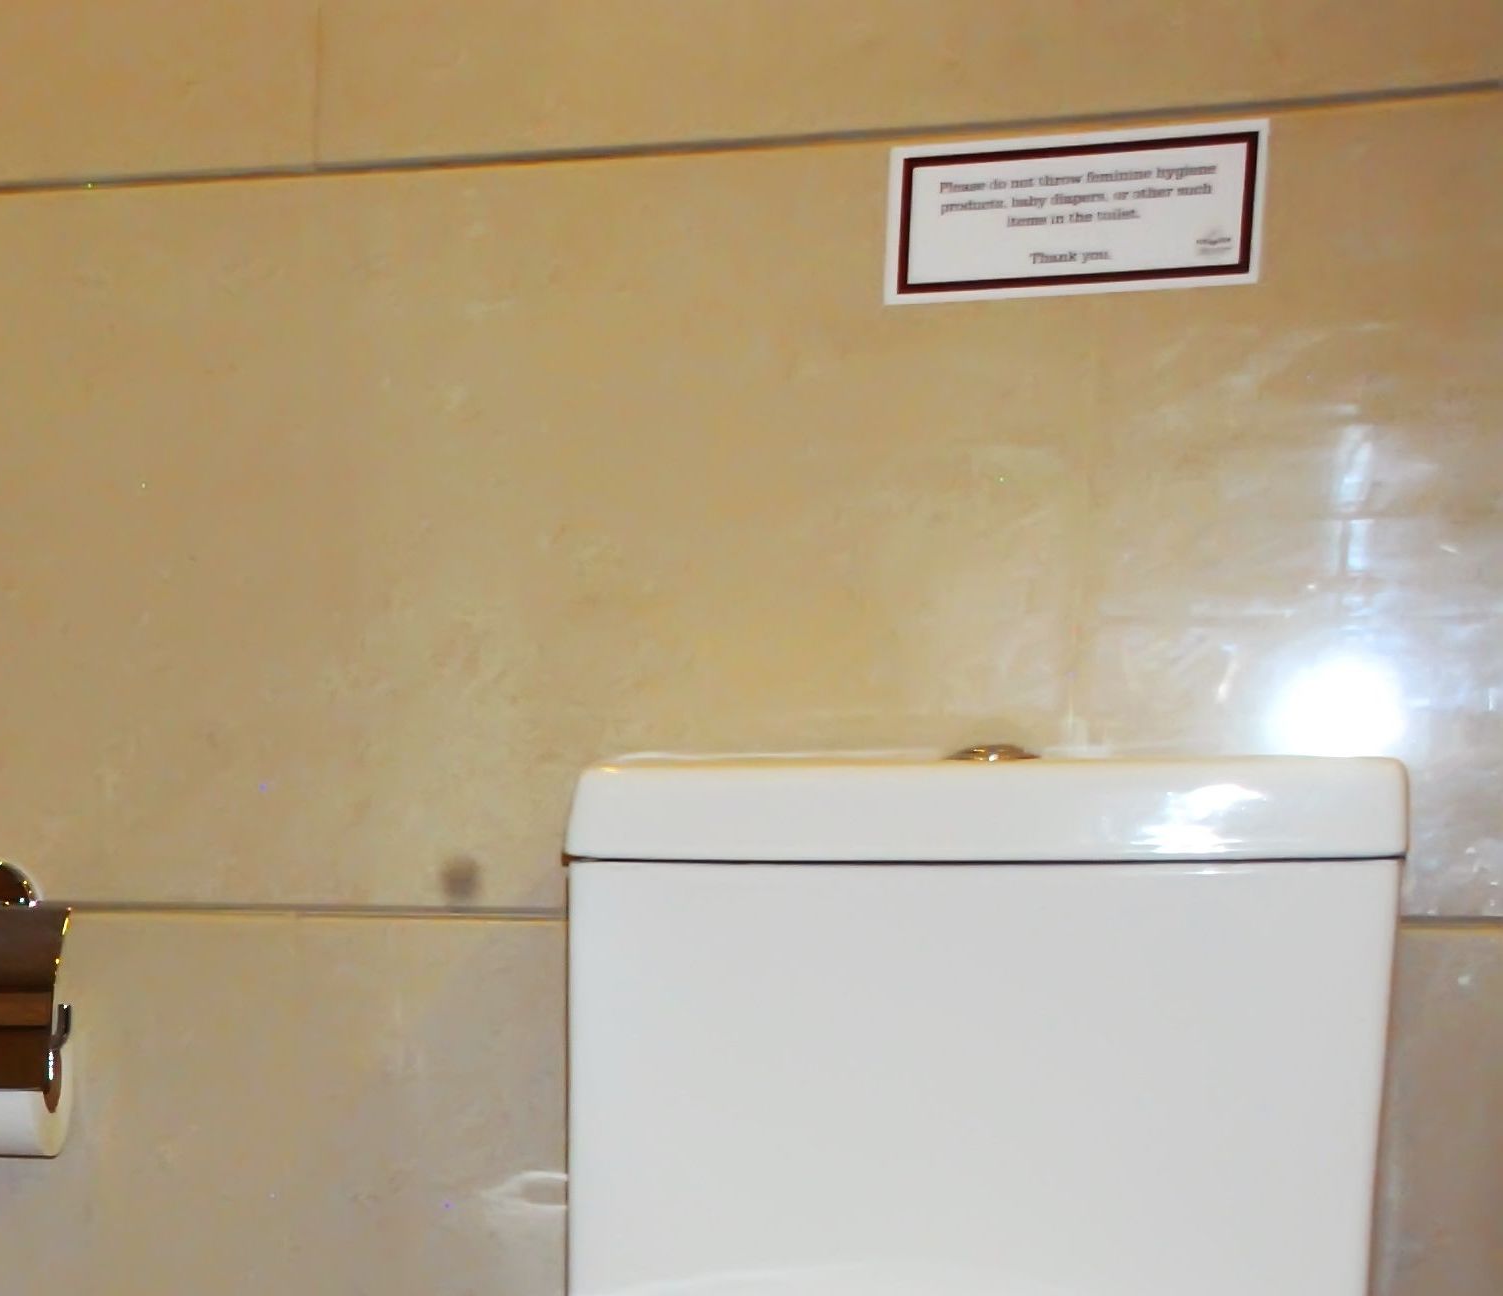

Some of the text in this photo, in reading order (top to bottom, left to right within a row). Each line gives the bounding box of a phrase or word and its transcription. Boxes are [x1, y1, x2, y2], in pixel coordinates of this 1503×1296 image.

[940, 164, 1217, 193] Please do not throw feminine hygiene
[1012, 196, 1047, 208] baby
[1113, 191, 1129, 200] or
[1133, 187, 1173, 199] other
[1007, 215, 1047, 227] items
[1051, 215, 1064, 225] in
[1069, 212, 1093, 223] the
[1030, 251, 1077, 264] Thank
